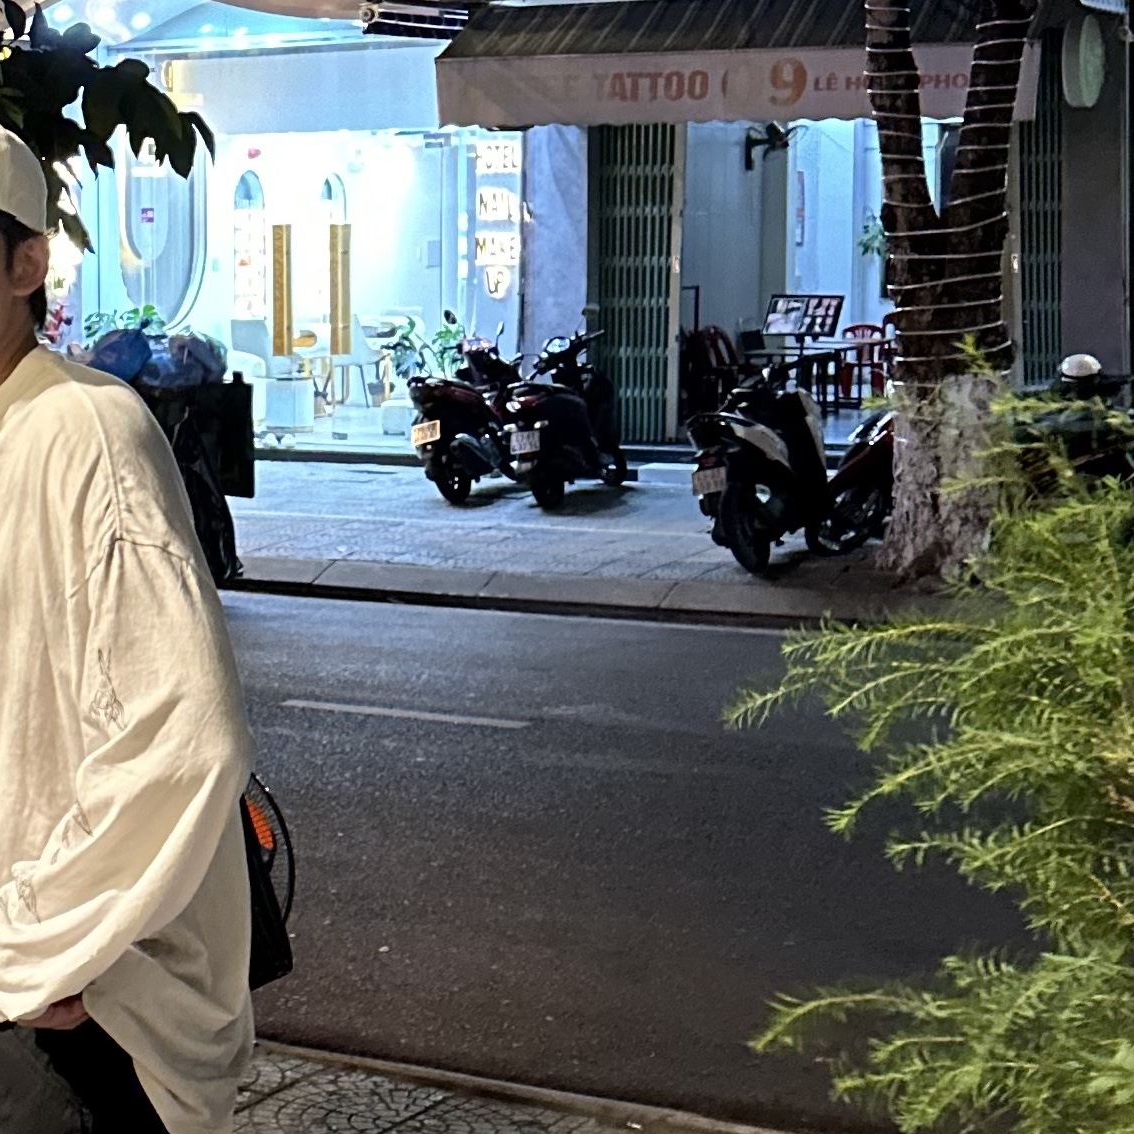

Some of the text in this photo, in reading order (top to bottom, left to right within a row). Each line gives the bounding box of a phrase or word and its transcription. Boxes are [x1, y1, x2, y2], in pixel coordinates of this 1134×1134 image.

[593, 70, 709, 101] TATTOO
[768, 58, 807, 107] 9
[919, 73, 967, 90] PHO
